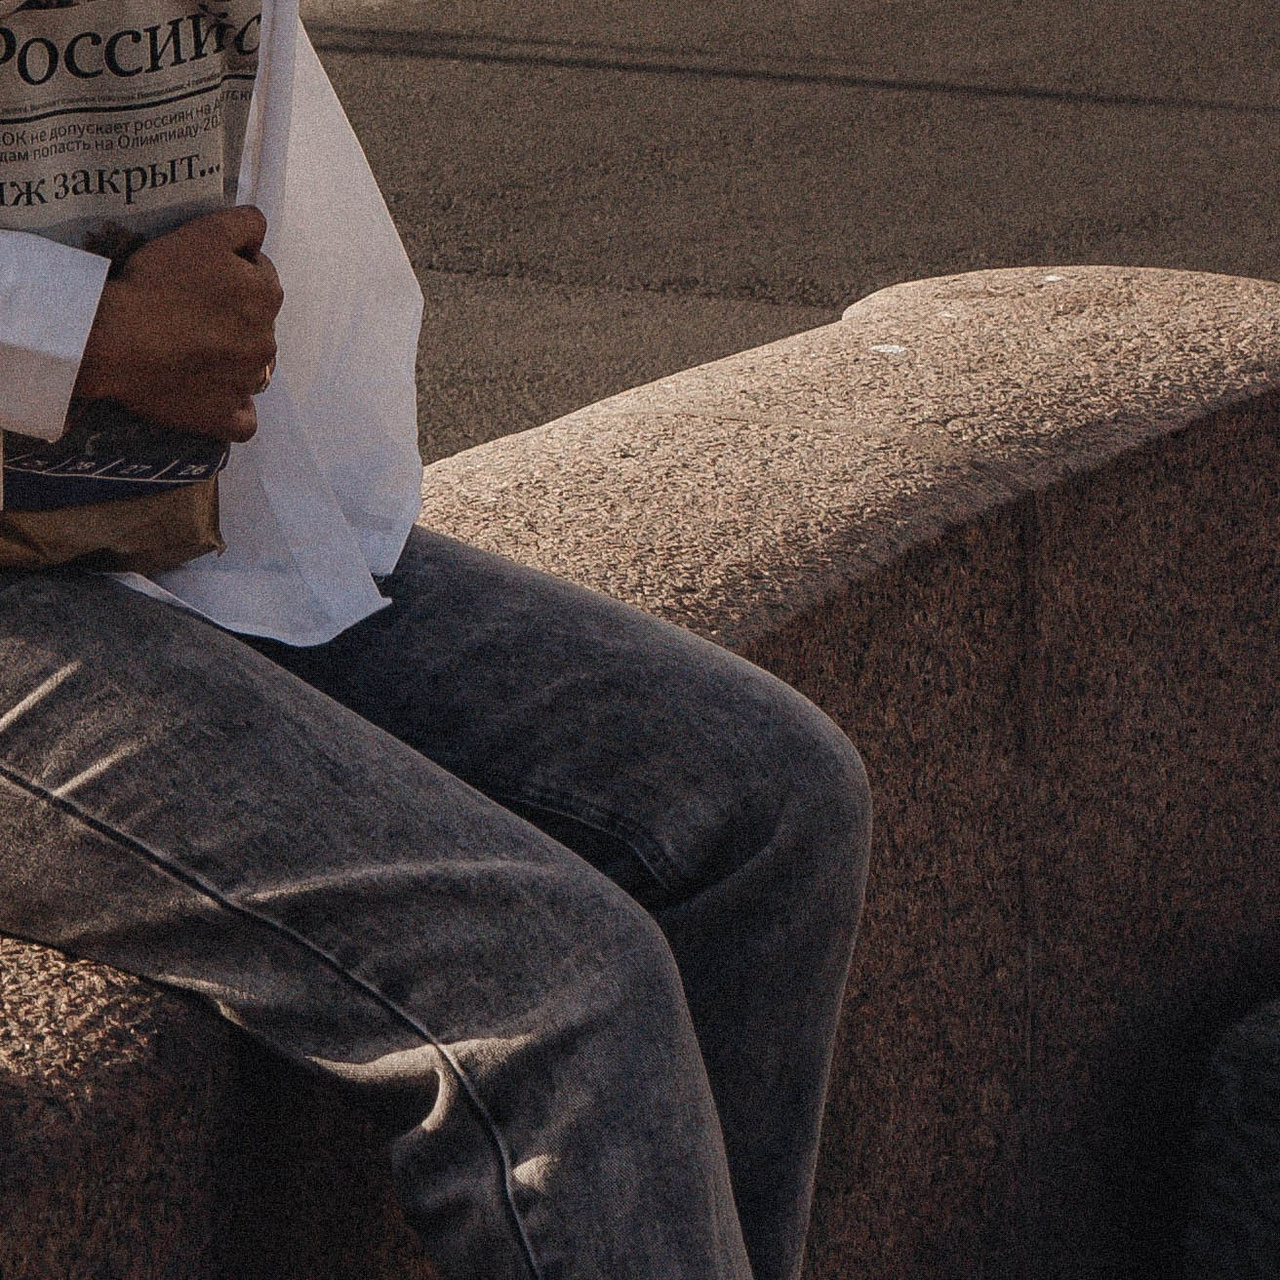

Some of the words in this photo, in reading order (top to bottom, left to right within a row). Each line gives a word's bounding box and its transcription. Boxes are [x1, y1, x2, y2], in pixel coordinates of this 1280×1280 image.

[30, 129, 49, 145] не
[49, 121, 131, 140] допускает
[133, 109, 195, 136] россиян
[196, 101, 212, 118] на
[33, 138, 92, 160] попасть
[95, 138, 114, 152] на
[53, 152, 220, 206] закрыт...
[176, 463, 210, 477] 26
